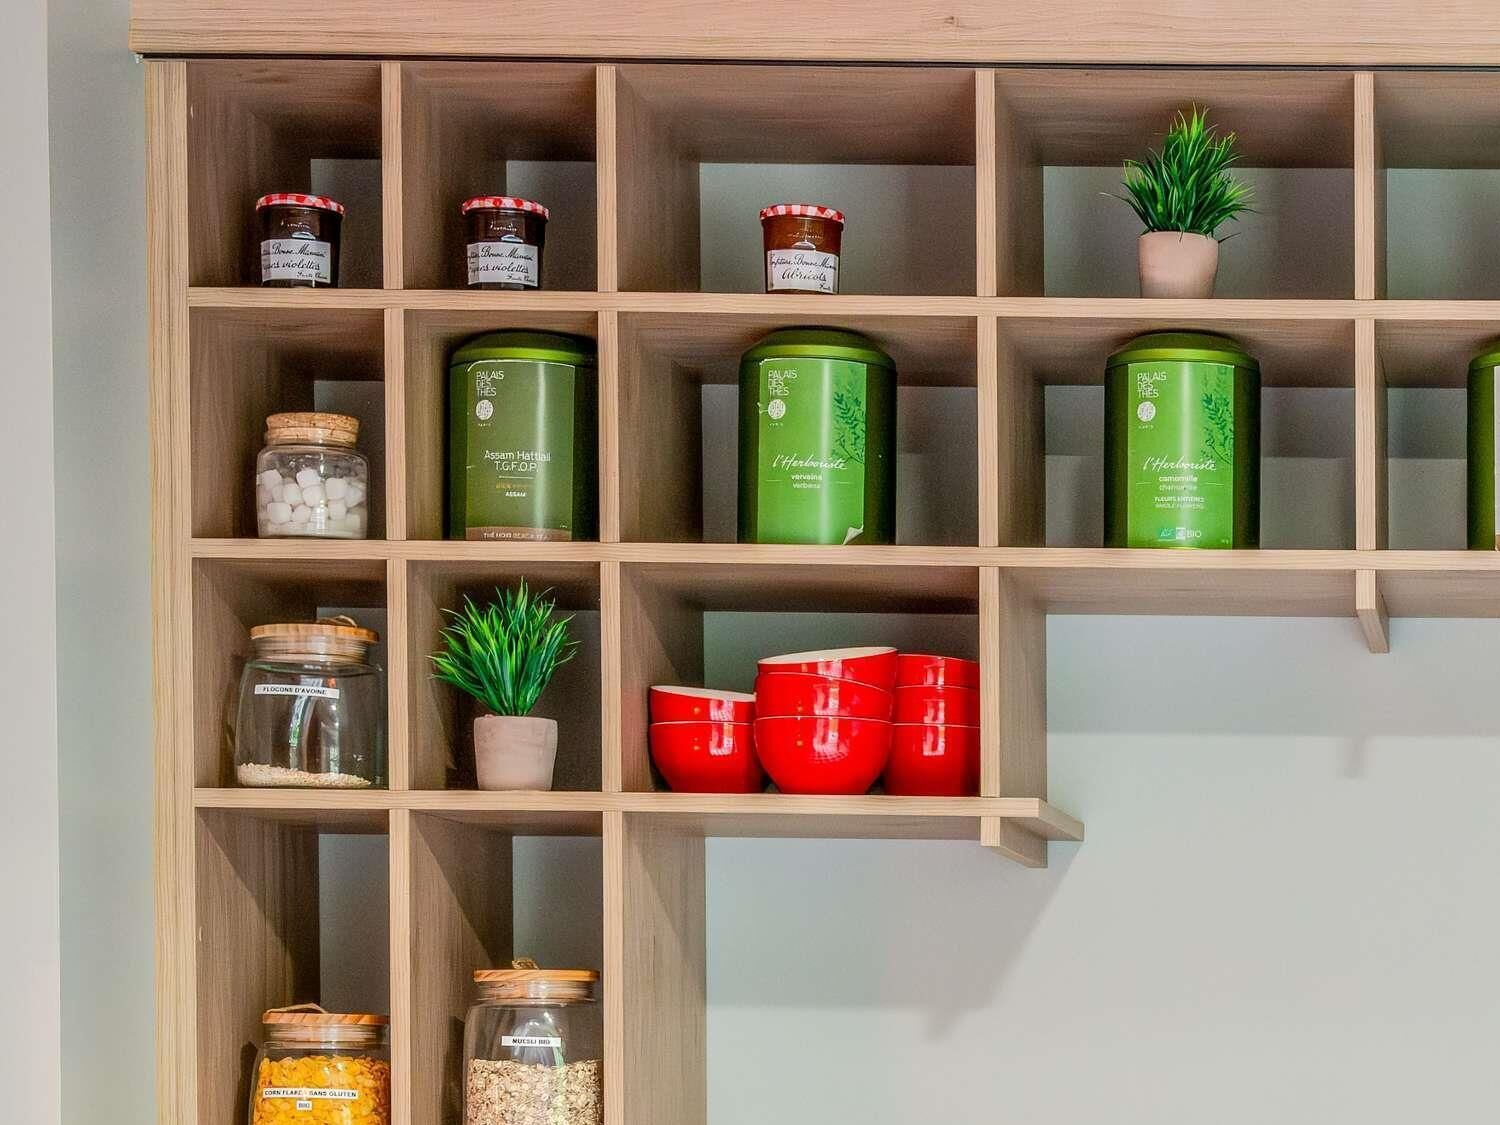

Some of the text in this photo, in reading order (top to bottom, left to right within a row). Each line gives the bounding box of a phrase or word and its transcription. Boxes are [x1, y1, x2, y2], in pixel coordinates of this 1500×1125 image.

[476, 370, 504, 380] PALAIS
[768, 369, 799, 379] PALAIS
[1137, 371, 1167, 381] PALAIS
[476, 380, 493, 388] DES
[768, 379, 784, 388] DES
[1137, 381, 1154, 390] DES
[484, 450, 515, 461] Assam
